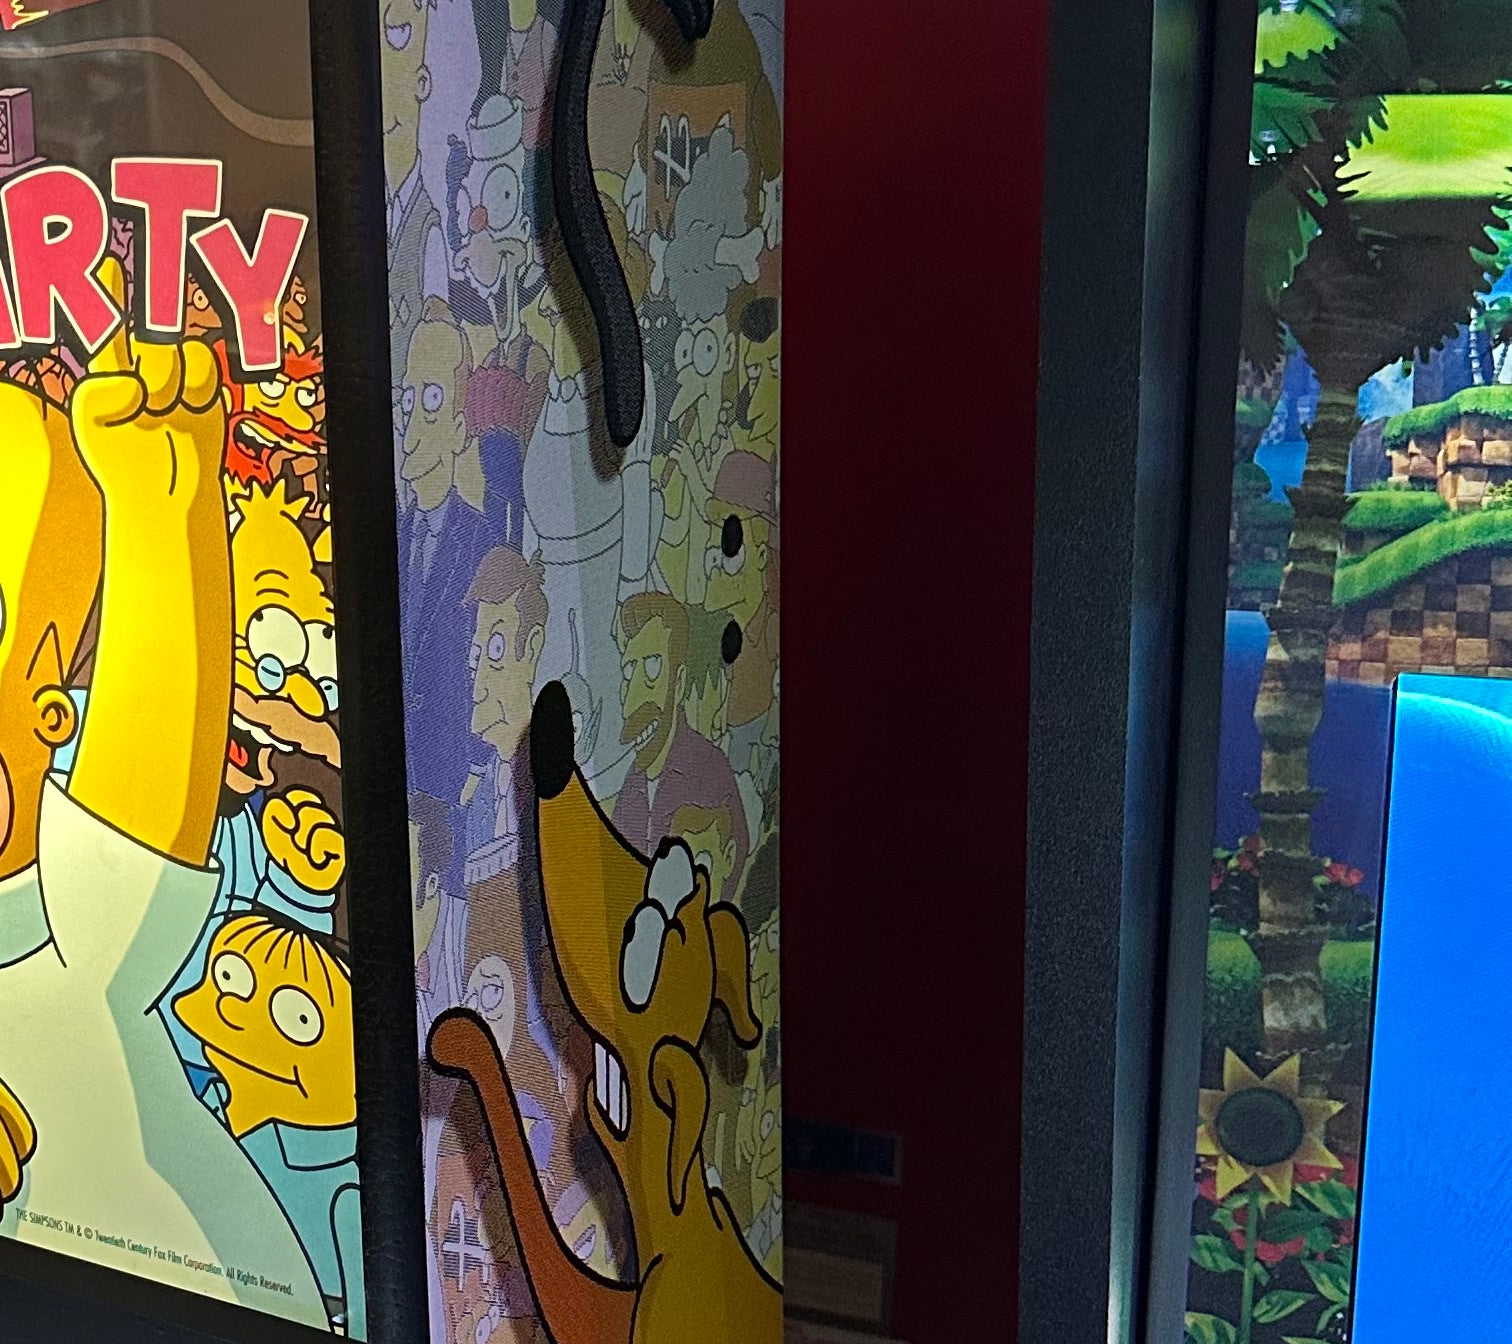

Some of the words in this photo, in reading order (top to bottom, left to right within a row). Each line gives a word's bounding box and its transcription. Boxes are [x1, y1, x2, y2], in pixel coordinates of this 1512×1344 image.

[16, 1207, 28, 1222] THE
[29, 1210, 64, 1232] SIMPSONS
[76, 1224, 83, 1237] &
[94, 1229, 126, 1249] Twentieth
[127, 1238, 152, 1259] Century
[153, 1245, 167, 1261] Fox
[168, 1249, 182, 1265] Film
[226, 1266, 235, 1280] All
[236, 1268, 259, 1287] Rights
[259, 1275, 295, 1297] Reserved.
